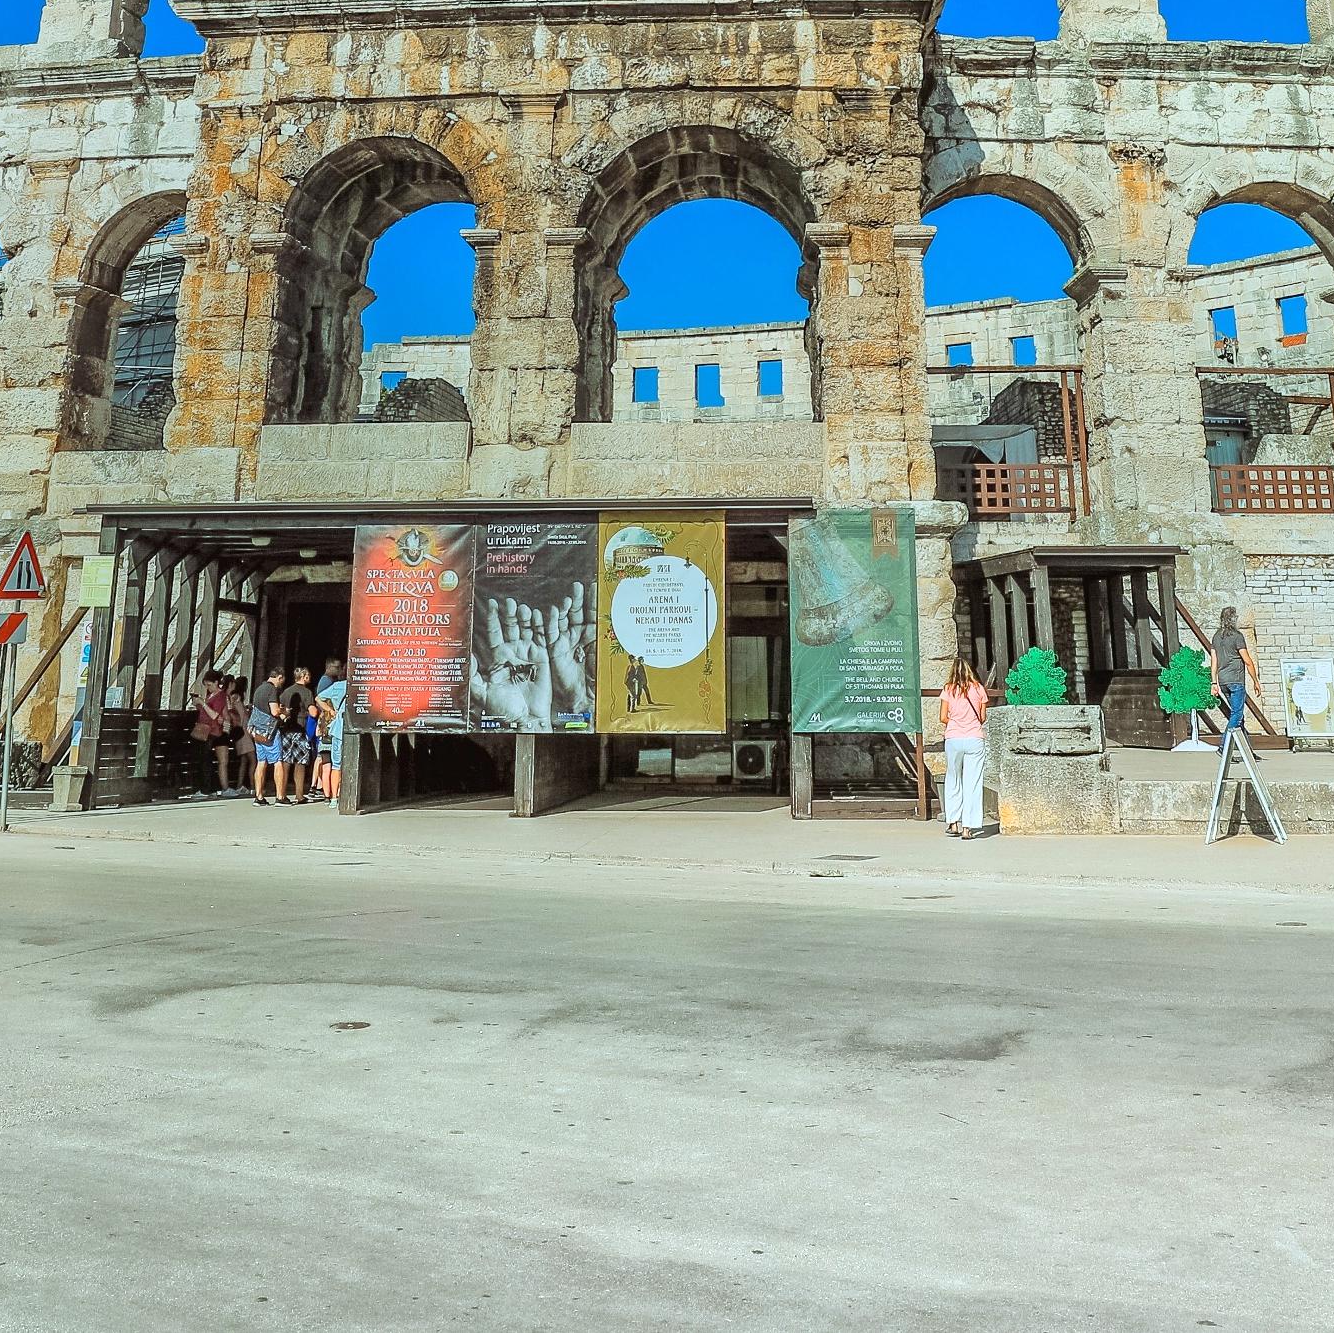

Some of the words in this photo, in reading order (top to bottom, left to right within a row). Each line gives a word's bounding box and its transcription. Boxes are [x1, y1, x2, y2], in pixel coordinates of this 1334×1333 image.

[487, 524, 540, 535] Prapovijest
[496, 536, 532, 545] rukama
[487, 553, 535, 564] Prehistory
[487, 565, 495, 573] in
[498, 565, 527, 573] hands
[393, 599, 428, 612] 2018
[371, 614, 451, 624] GLADIATORS
[669, 616, 693, 624] DANAS
[378, 628, 412, 636] ARENA
[414, 628, 441, 636] PULA
[403, 648, 426, 656] 20.30
